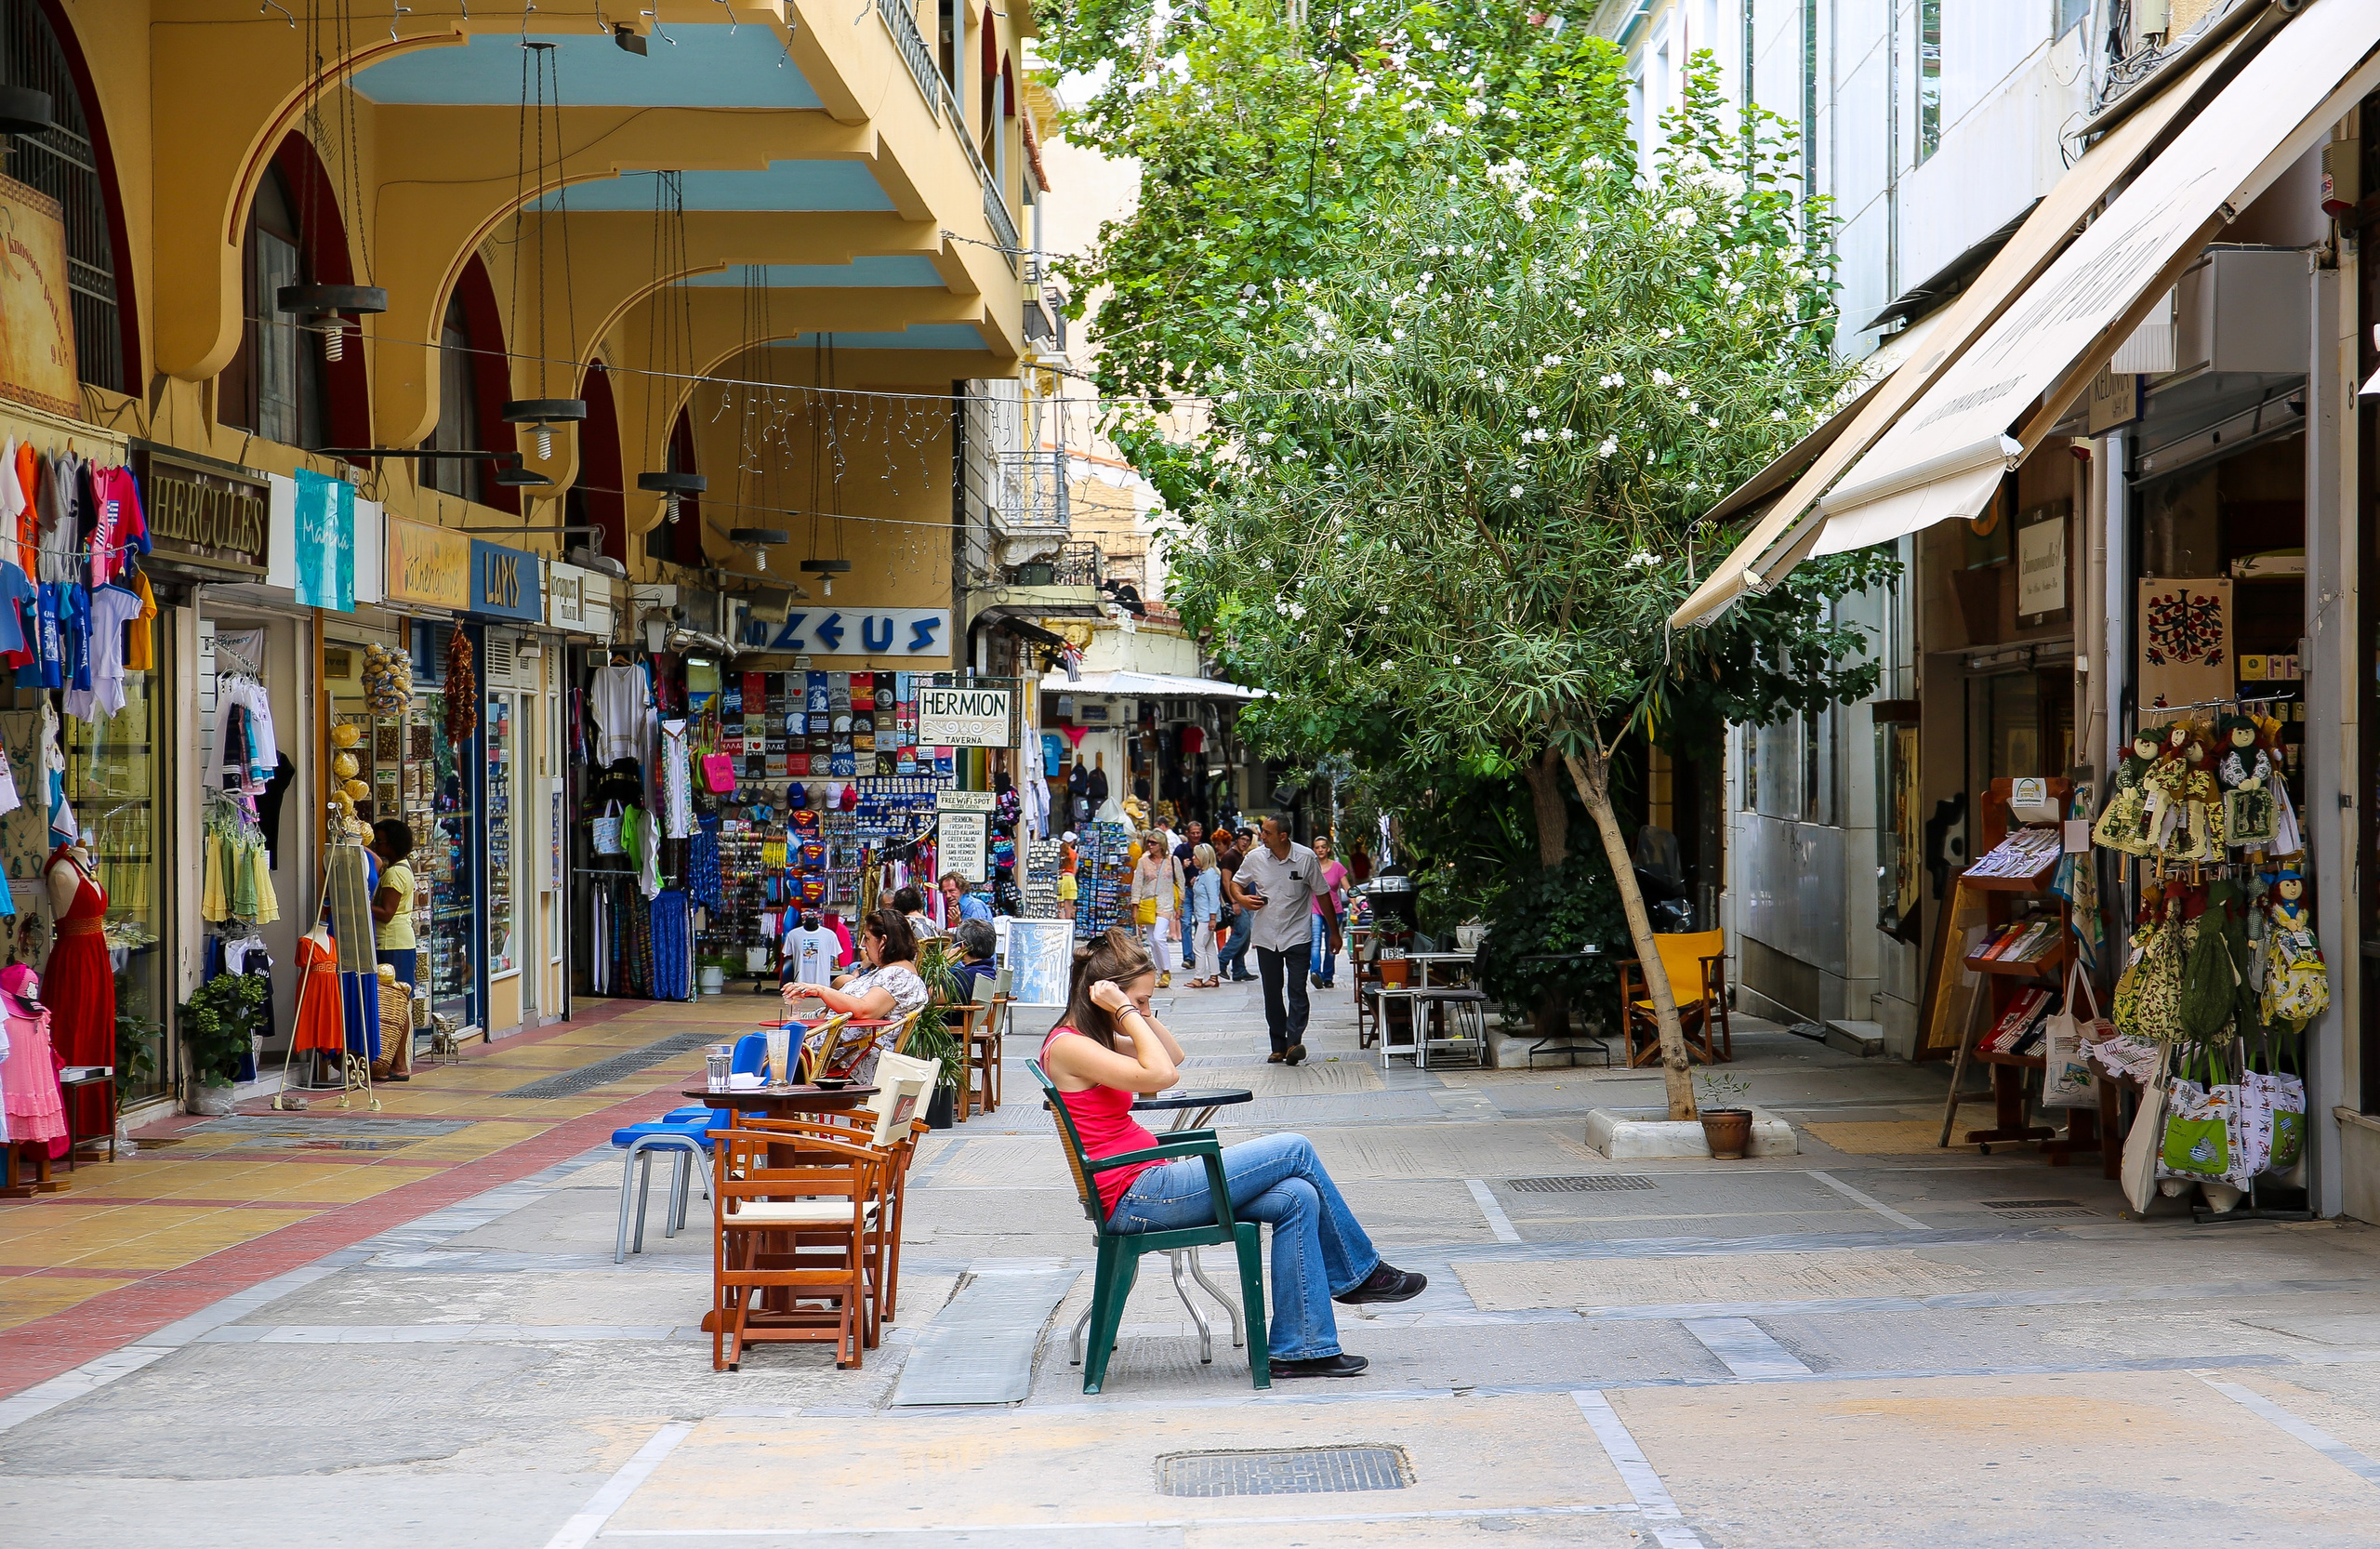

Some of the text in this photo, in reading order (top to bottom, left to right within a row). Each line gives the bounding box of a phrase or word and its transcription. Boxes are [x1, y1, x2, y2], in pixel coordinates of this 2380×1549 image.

[7, 232, 43, 285] knossos
[2347, 380, 2355, 410] 8
[150, 475, 264, 556] HERCULES
[302, 510, 350, 551] Marina
[484, 551, 521, 608] LAPIS
[216, 634, 251, 647] Greece
[769, 612, 942, 652] ZEUS
[324, 656, 347, 667] ives
[922, 692, 1006, 717] HERMION
[945, 736, 983, 745] TAVERNA
